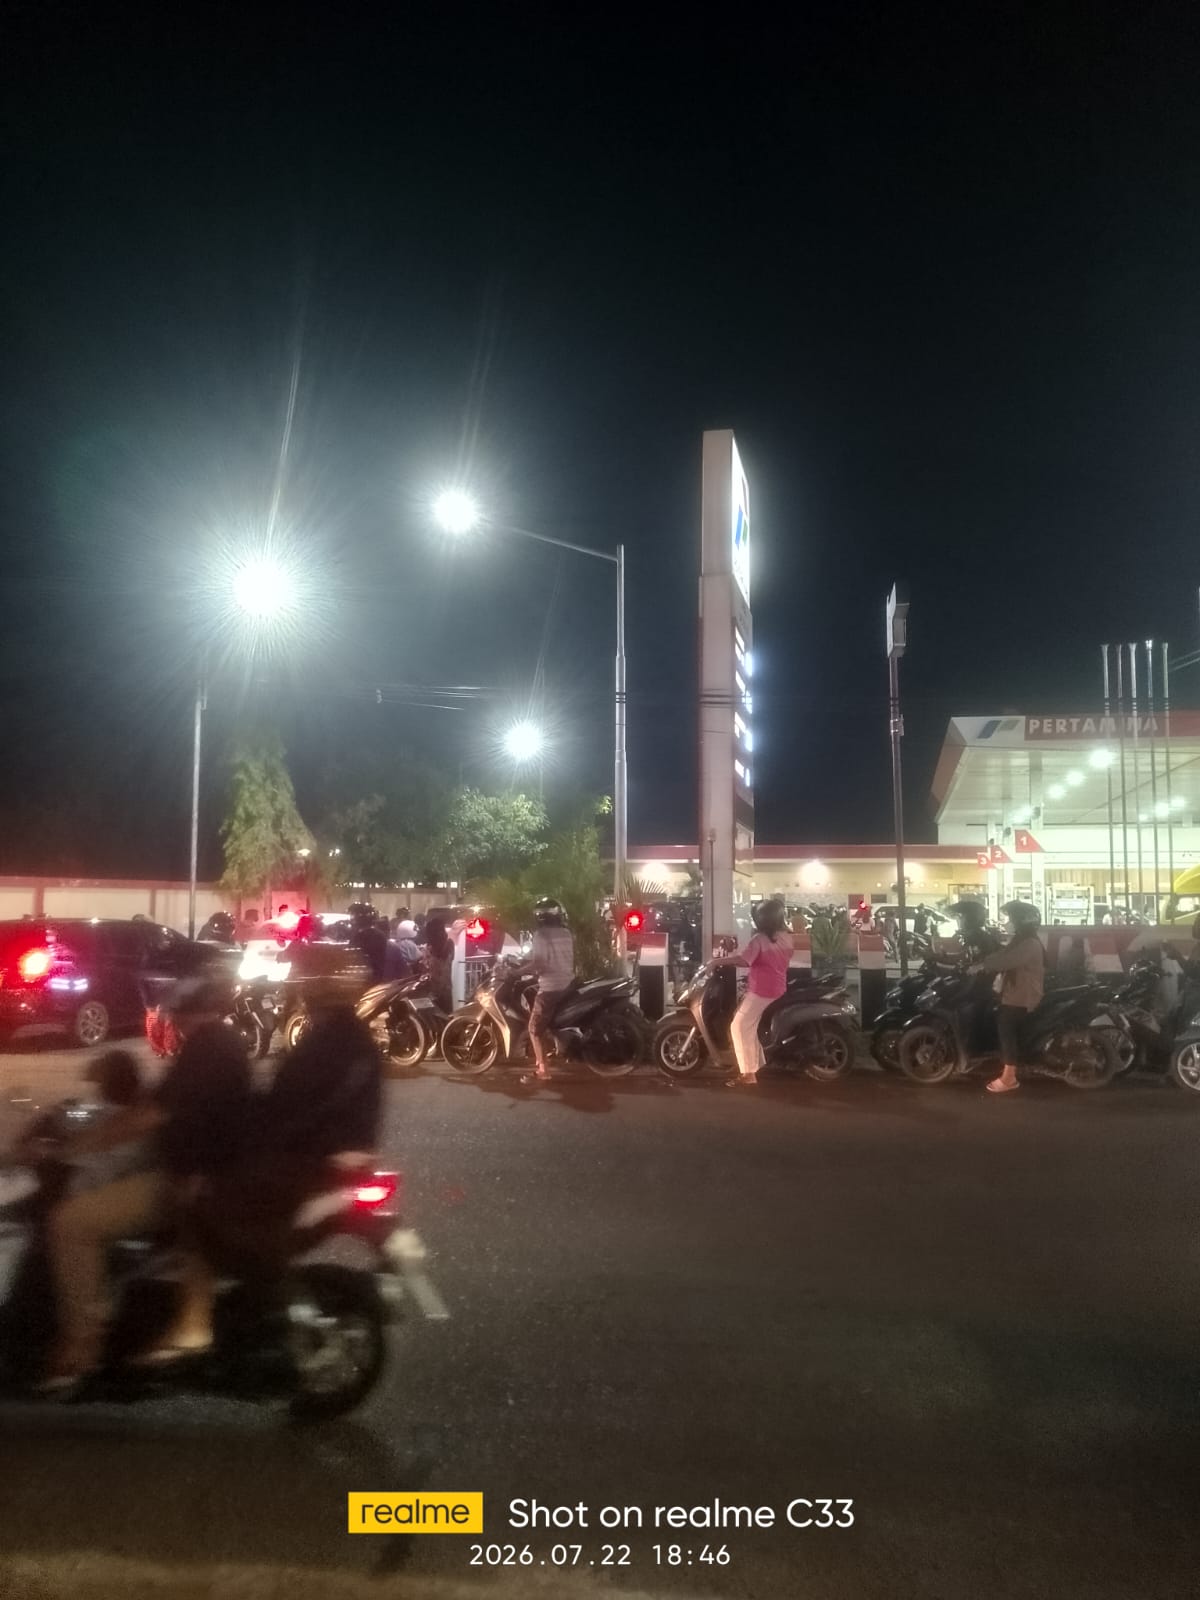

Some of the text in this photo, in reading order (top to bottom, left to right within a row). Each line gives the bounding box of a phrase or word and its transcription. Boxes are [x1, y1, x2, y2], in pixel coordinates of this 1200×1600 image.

[1029, 717, 1159, 734] PERTAMNA
[1020, 836, 1027, 846] 1
[994, 850, 1002, 858] 2
[980, 857, 987, 865] 3
